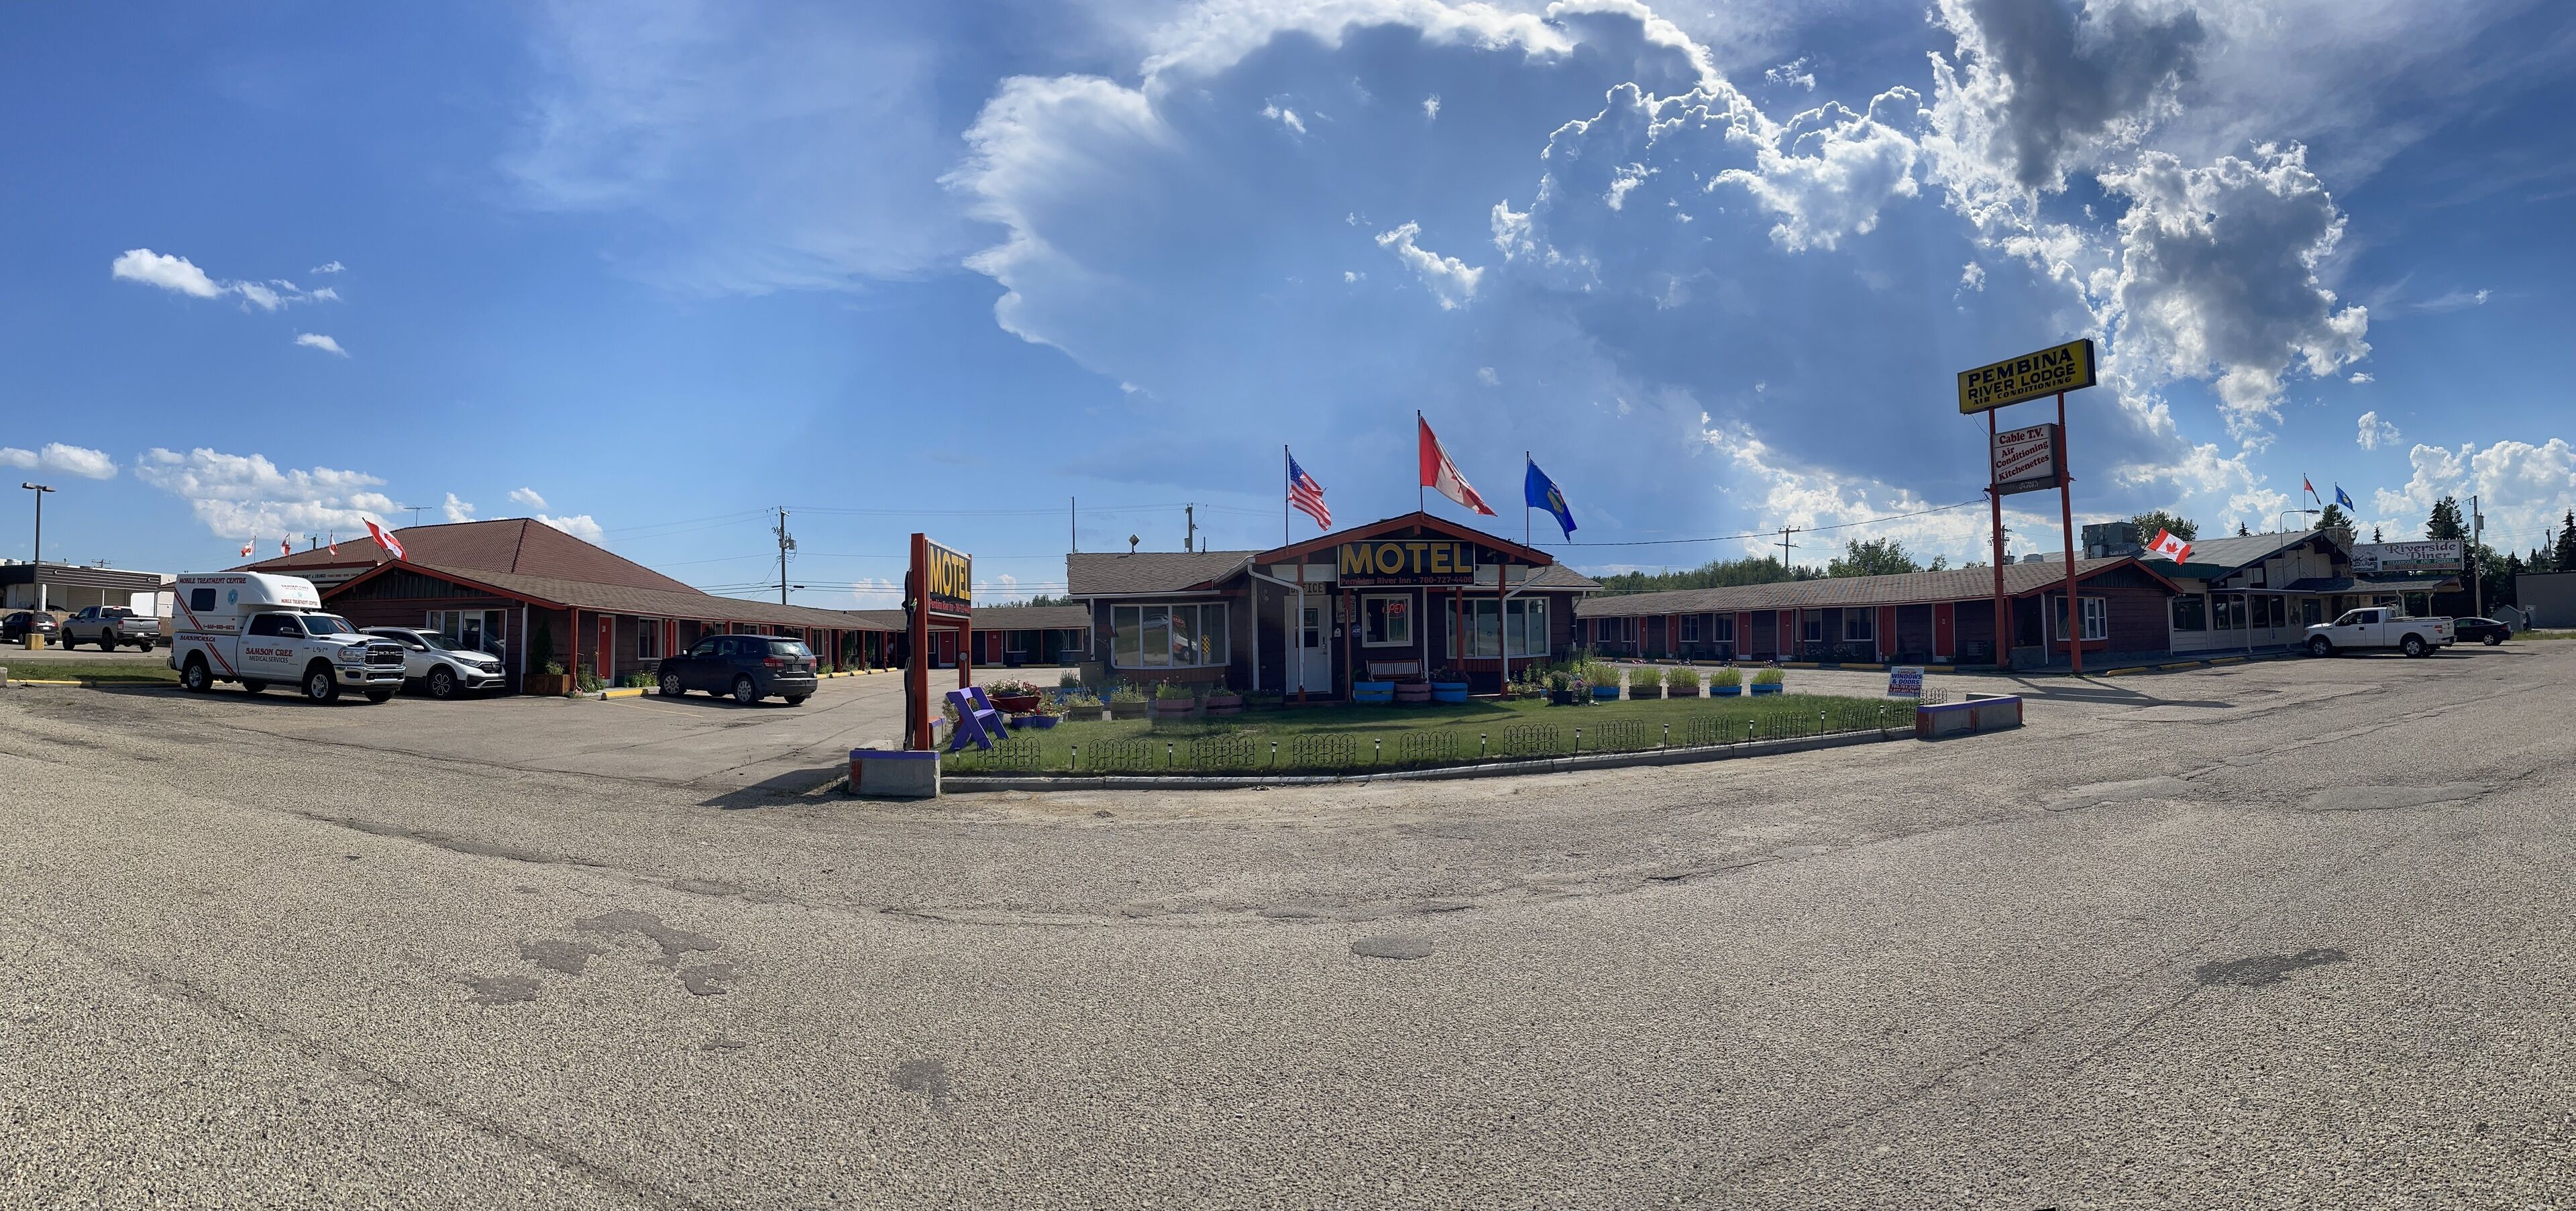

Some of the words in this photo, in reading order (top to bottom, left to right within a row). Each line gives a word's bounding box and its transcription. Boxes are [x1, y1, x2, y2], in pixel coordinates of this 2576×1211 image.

[1968, 348, 2073, 388] PEMBINA
[1968, 378, 2015, 400] RIVER
[2021, 362, 2076, 386] LODGE
[1973, 396, 1990, 406] AIR
[1997, 376, 2072, 399] CONDITIONING
[1999, 432, 2025, 444] Cable
[2027, 427, 2043, 439] T.V.
[1996, 440, 2049, 468] Conditioning
[2001, 447, 2015, 458] Air
[1998, 454, 2049, 481] Kitchenettes
[1341, 543, 1472, 575] MOTEL
[2385, 541, 2457, 555] Riverside
[2406, 551, 2451, 560] Diner
[930, 545, 971, 600] MOTEL
[246, 647, 274, 656] SAMSON
[275, 649, 293, 657] CREE
